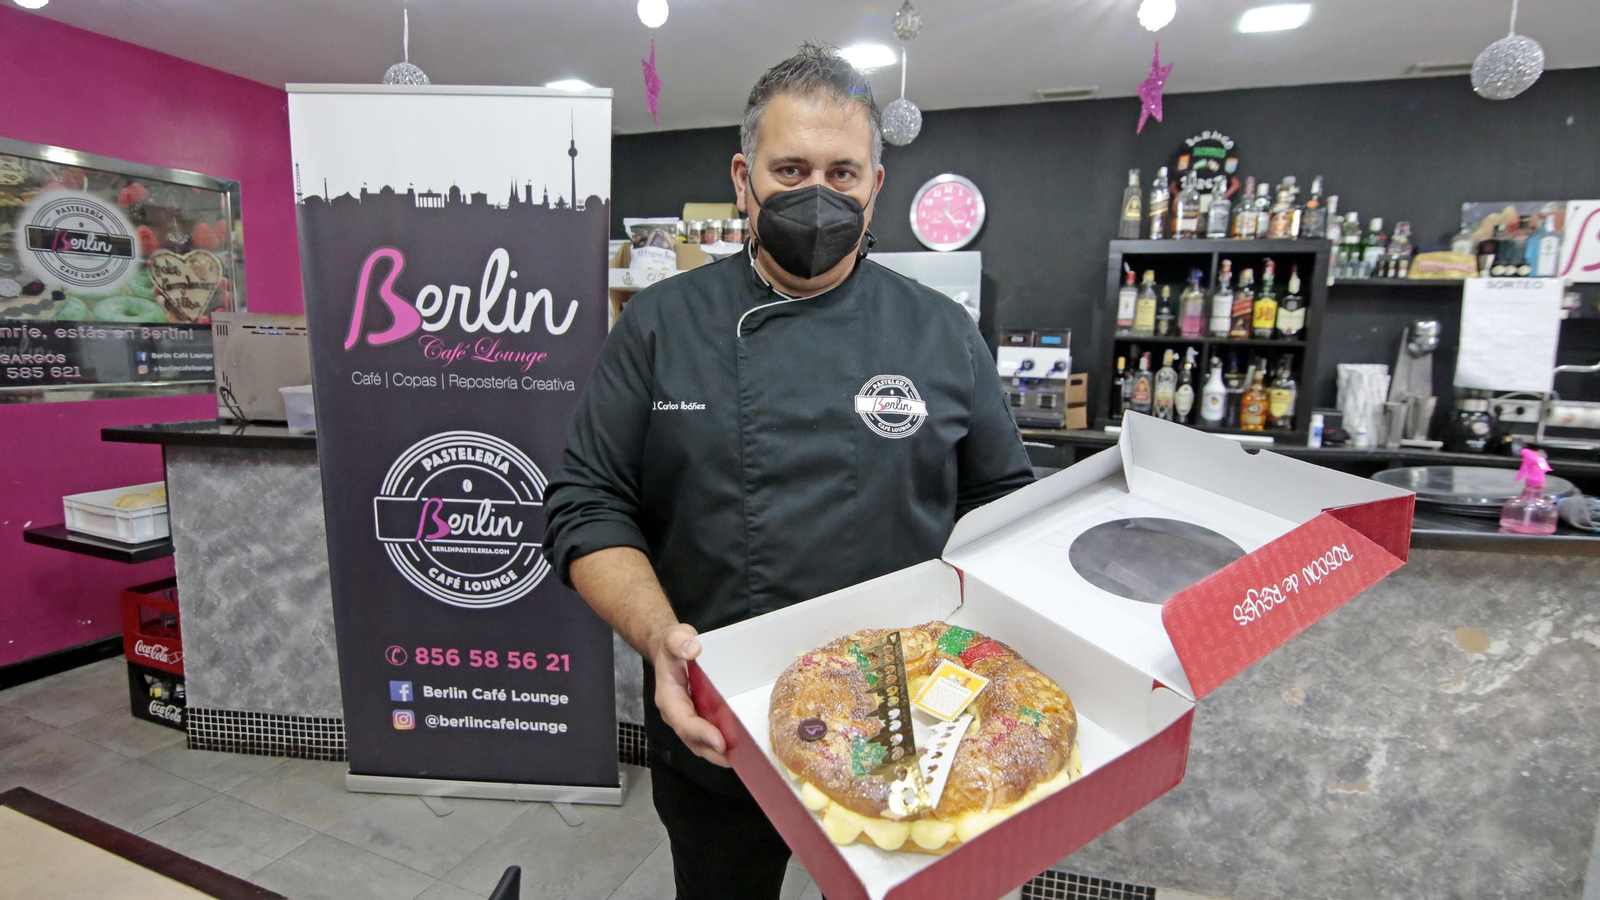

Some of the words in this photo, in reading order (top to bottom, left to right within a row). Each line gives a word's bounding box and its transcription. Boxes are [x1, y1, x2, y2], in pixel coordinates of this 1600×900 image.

[52, 228, 112, 253] Berlin
[81, 268, 110, 279] LOUNGE
[1486, 280, 1544, 290] SORTEO
[344, 246, 579, 352] Berlin
[55, 326, 107, 339] estás
[112, 329, 135, 340] en
[190, 352, 213, 361] Lounge
[418, 334, 470, 368] Café
[471, 336, 548, 372] Lounge
[7, 366, 45, 379] 585
[50, 366, 81, 378] 621
[351, 371, 382, 386] Café
[392, 372, 437, 389] Copas
[449, 373, 518, 391] Repostería
[520, 375, 576, 391] Creativa
[657, 400, 679, 410] Carlos
[680, 400, 706, 410] Ibáñez
[872, 396, 912, 413] Berlin
[891, 422, 912, 433] LOUNGE
[421, 447, 510, 475] PASTELERÍA
[414, 497, 523, 543] Berlin
[432, 545, 510, 555] BERLINPASTELERIA.COM
[1302, 543, 1354, 586] ROSCÓN
[428, 567, 460, 590] CAFÉ
[464, 569, 518, 592] LOUNGE
[1282, 573, 1299, 594] de
[415, 647, 461, 667] 856
[469, 650, 499, 668] 58
[507, 651, 538, 670] 56
[546, 653, 570, 672] 21
[423, 685, 467, 699] Berlin
[472, 687, 507, 702] Café
[511, 690, 569, 706] Lounge
[425, 714, 568, 734] @berlincafelounge
